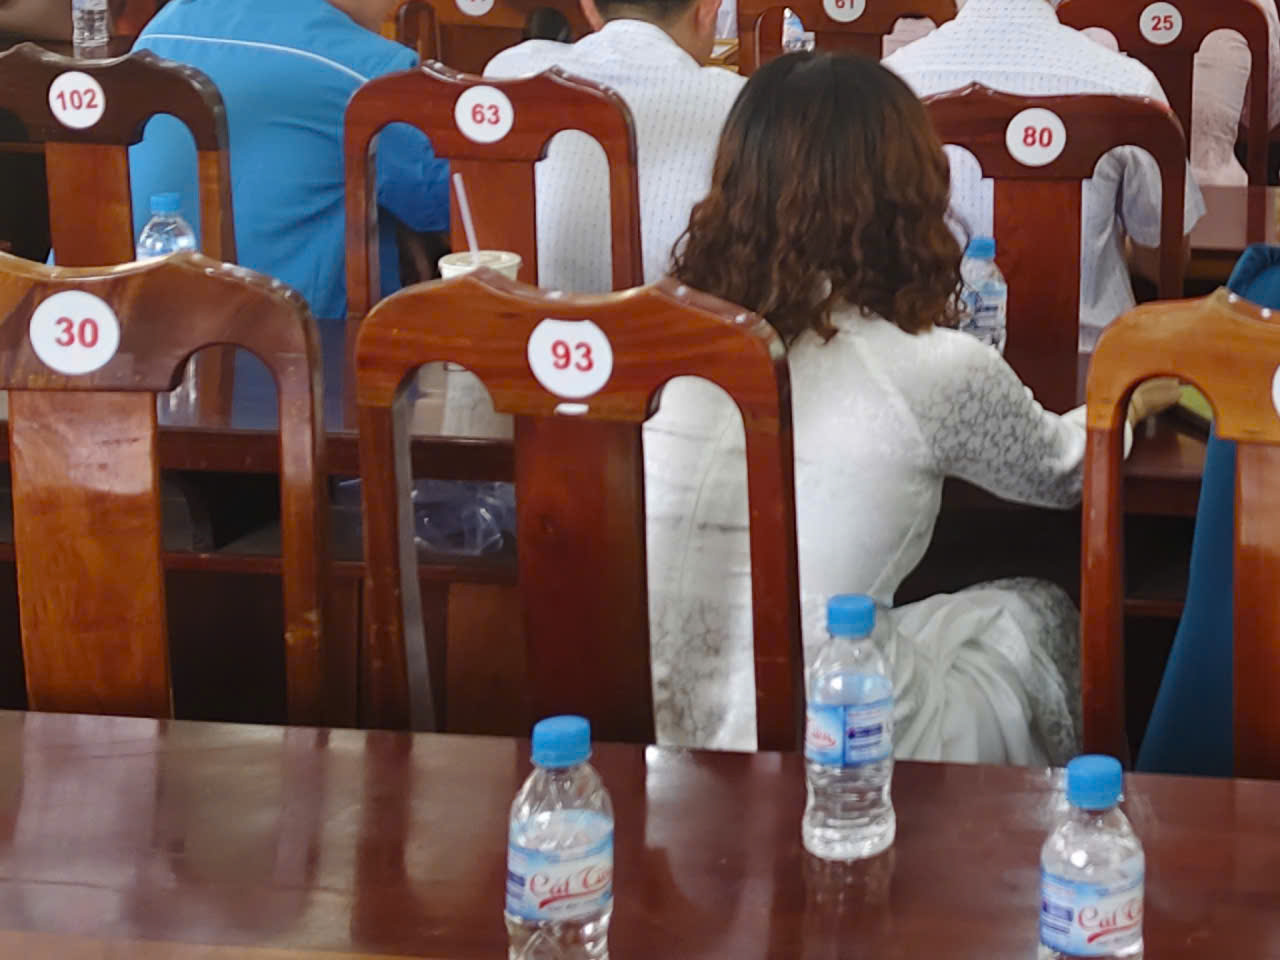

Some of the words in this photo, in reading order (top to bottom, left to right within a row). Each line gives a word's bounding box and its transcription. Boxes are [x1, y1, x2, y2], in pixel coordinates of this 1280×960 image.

[1151, 14, 1174, 32] 25
[56, 87, 98, 111] 102
[471, 103, 502, 127] 63
[1022, 125, 1054, 149] 80
[55, 316, 99, 348] 30
[551, 340, 594, 373] 93
